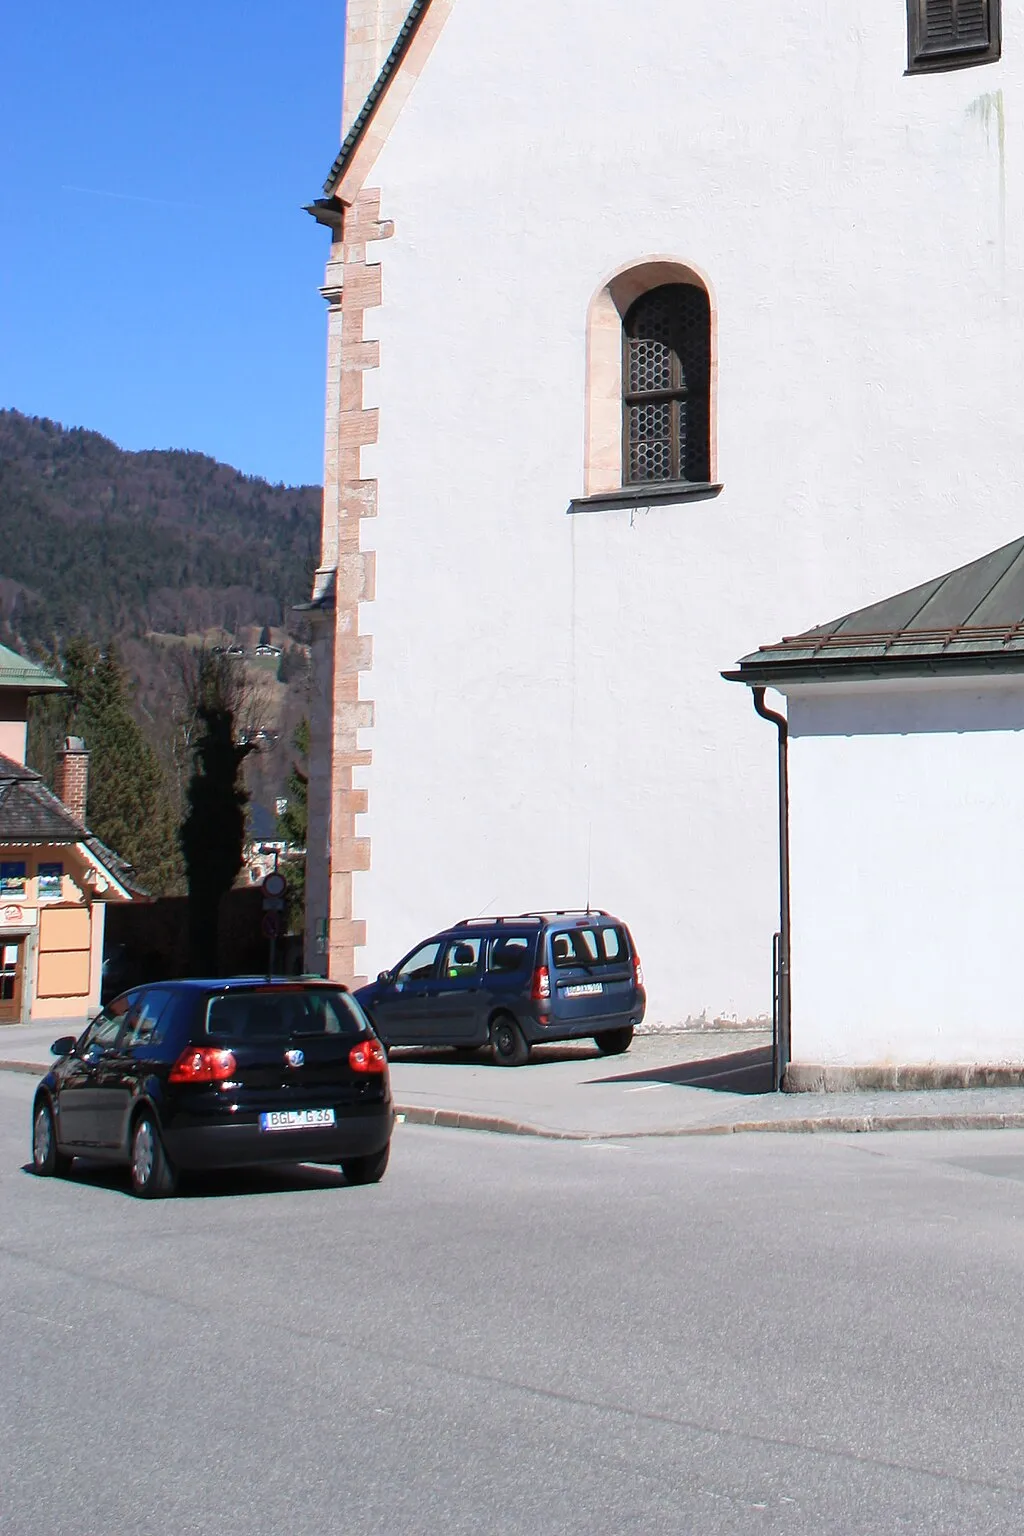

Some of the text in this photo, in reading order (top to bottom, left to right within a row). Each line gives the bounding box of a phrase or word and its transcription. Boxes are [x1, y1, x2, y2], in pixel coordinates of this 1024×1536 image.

[271, 1108, 331, 1125] BGL G 36
